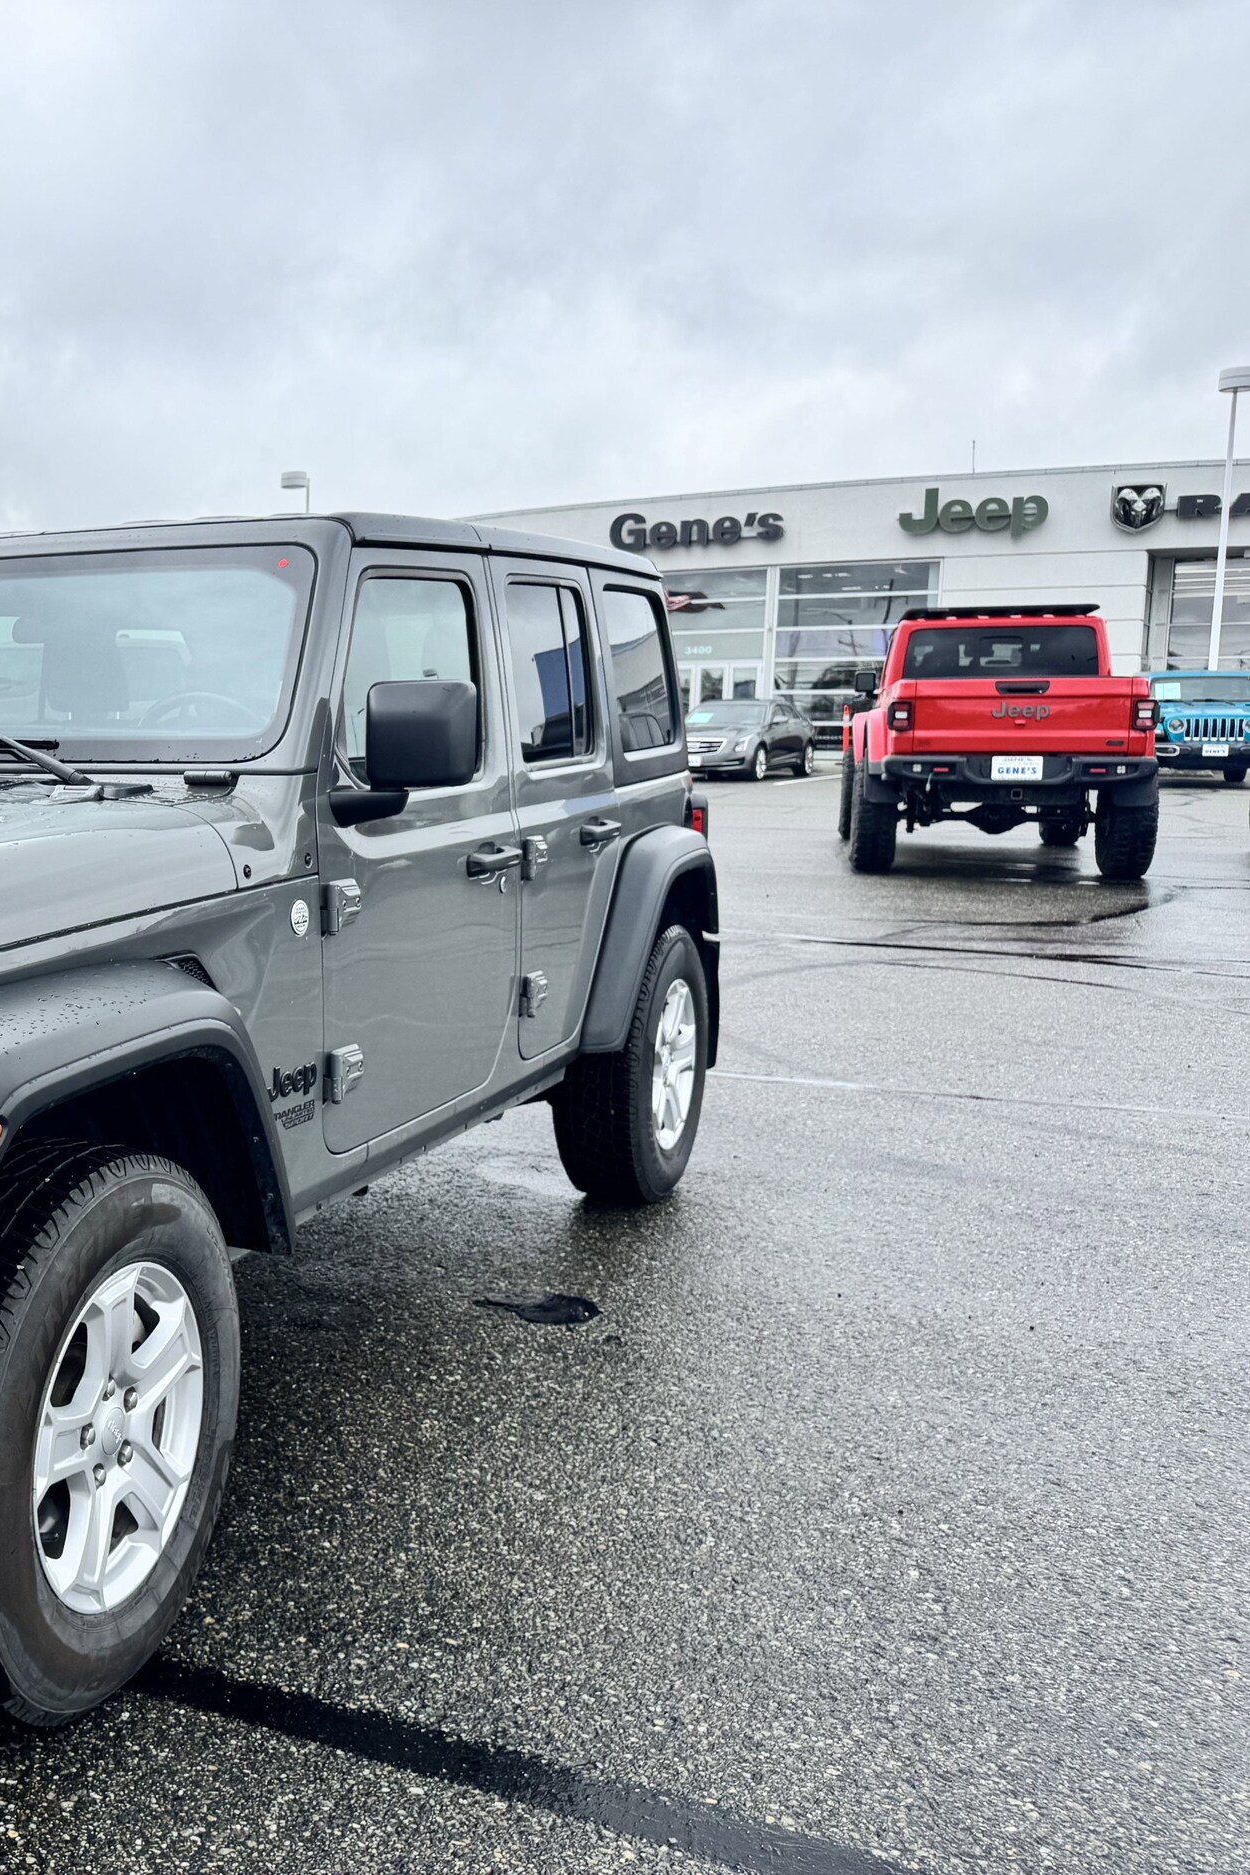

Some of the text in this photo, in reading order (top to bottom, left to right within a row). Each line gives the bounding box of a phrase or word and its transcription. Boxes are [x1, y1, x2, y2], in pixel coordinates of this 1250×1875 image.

[898, 487, 1049, 537] Jeep
[609, 512, 784, 550] Gene's
[684, 645, 713, 655] 3400
[991, 701, 1049, 720] Jeep
[998, 766, 1037, 775] GENE'S
[266, 1062, 317, 1102] Jeep
[274, 1100, 315, 1120] RANGLER
